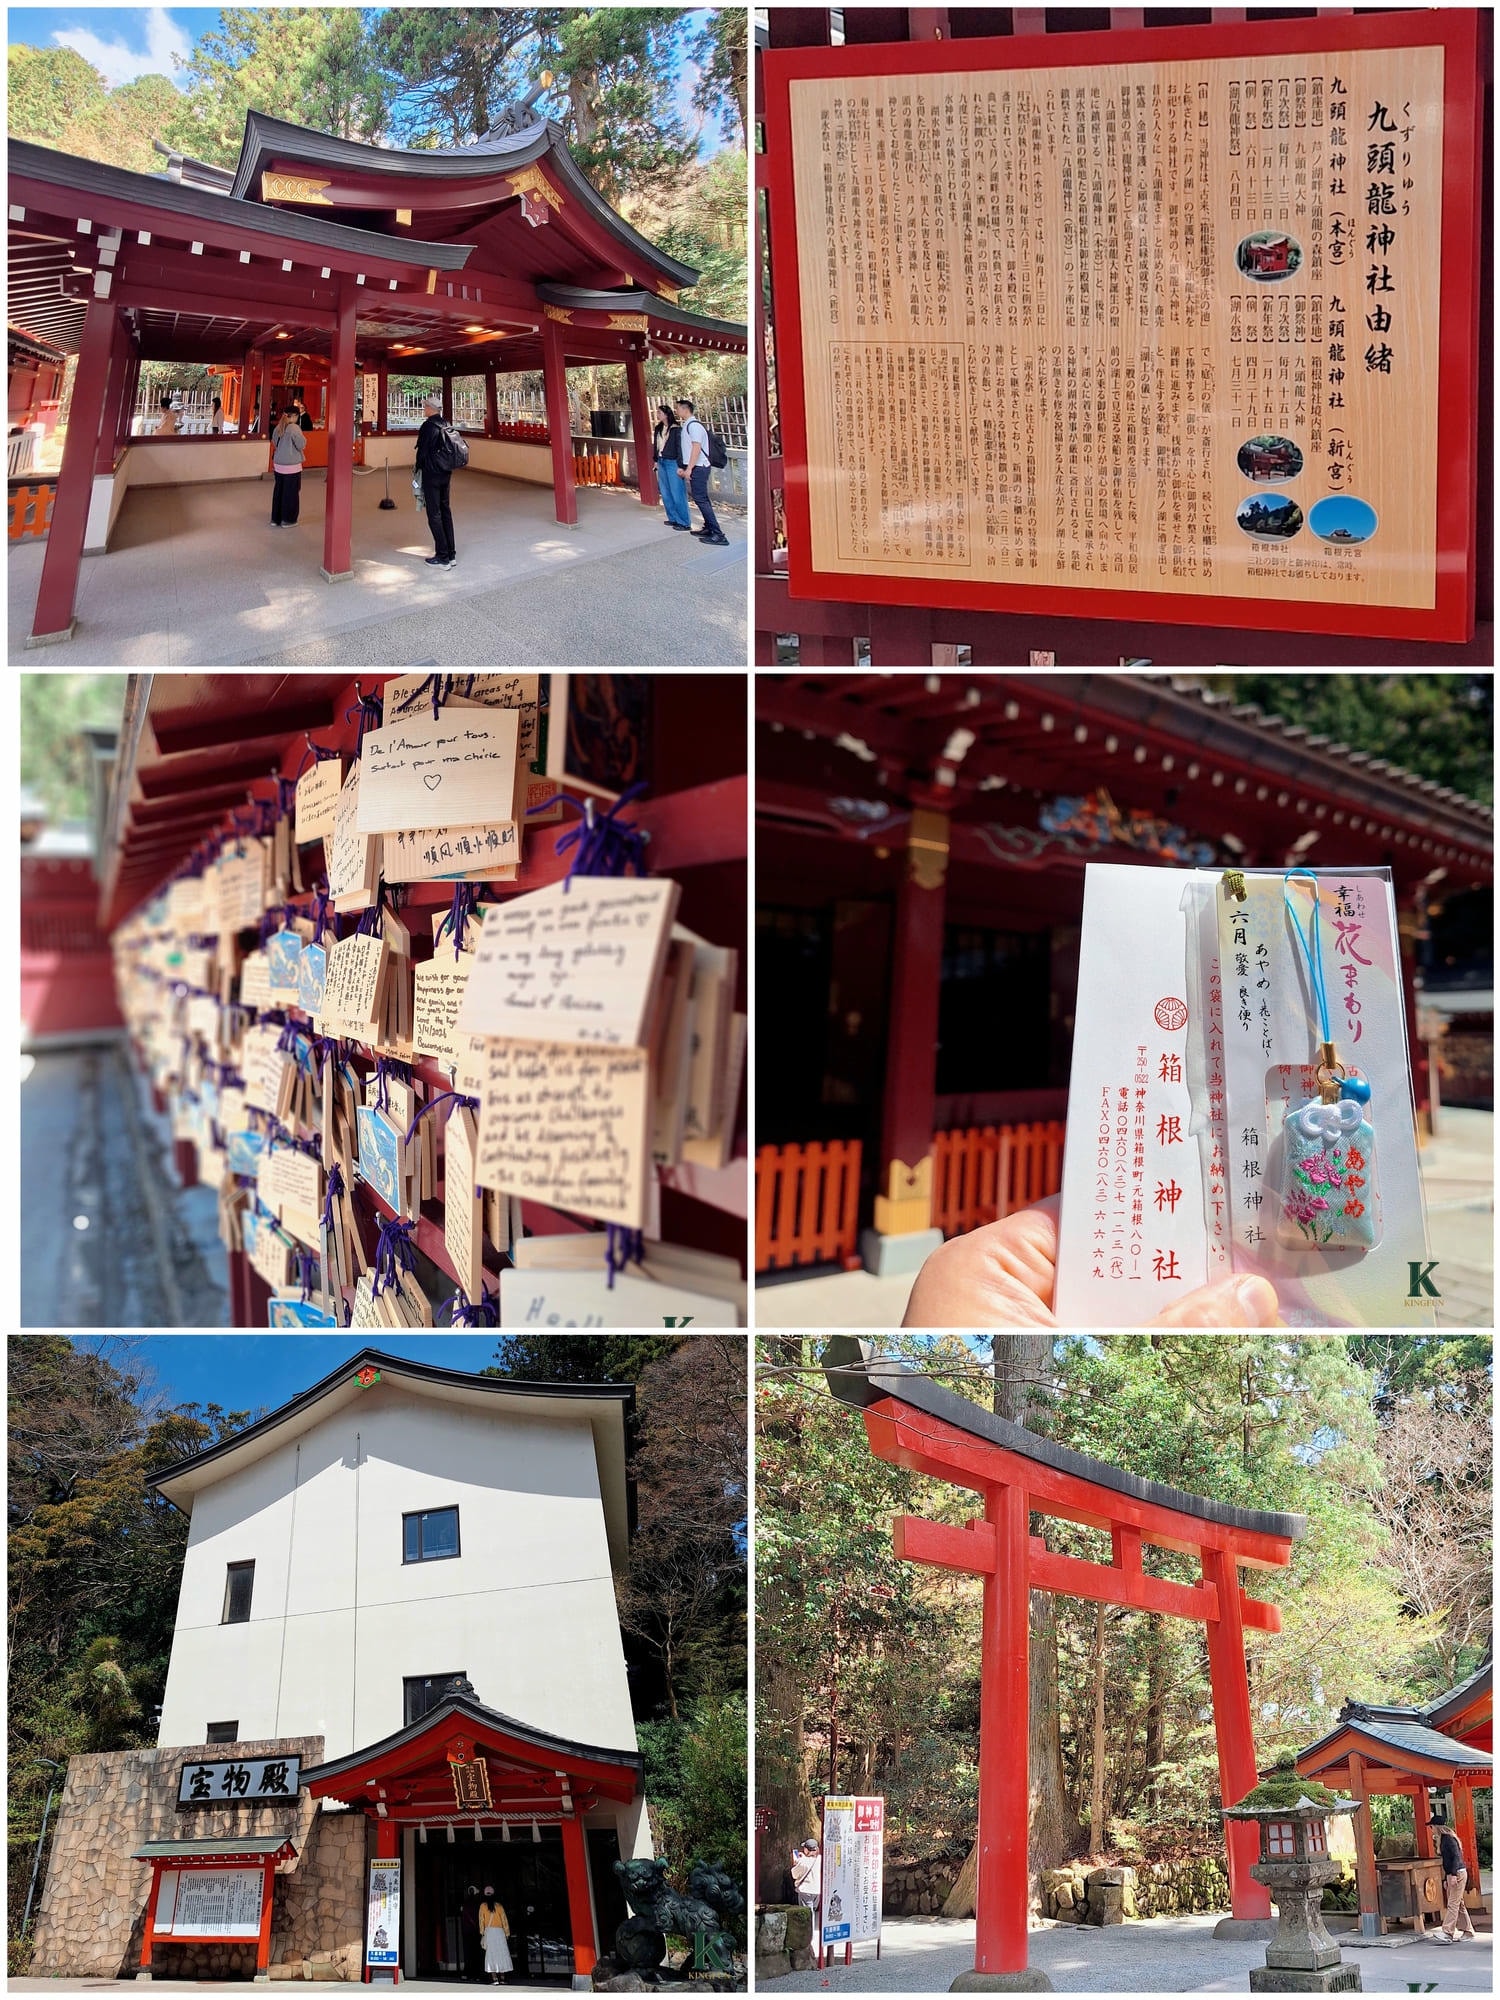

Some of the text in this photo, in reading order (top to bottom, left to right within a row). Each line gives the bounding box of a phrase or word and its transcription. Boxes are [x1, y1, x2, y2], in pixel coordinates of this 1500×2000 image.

[1230, 170, 1241, 220] 八月四日
[1295, 142, 1306, 217] 九頭龍大神
[1400, 101, 1416, 217] くずりゅう
[1347, 218, 1356, 259] ほんぐう
[1364, 100, 1398, 375] 九頭龍神社由緒
[1231, 356, 1242, 428] 七月三十一日
[1246, 356, 1258, 428] 四月二十九日
[1294, 356, 1306, 426] 九頭龍大神
[1310, 356, 1322, 453] 箱根神社境内鎮座
[1345, 439, 1354, 485] しんぐう
[1251, 543, 1289, 553] 箱根神社
[1324, 547, 1362, 558] 箱根元宮
[370, 744, 385, 756] De
[437, 736, 458, 748] pour
[413, 759, 435, 770] pour
[1356, 885, 1366, 919] しあわせ
[1229, 910, 1252, 1032] 六月 敬愛 良き便り
[1255, 943, 1271, 990] あやめ
[1332, 884, 1373, 1044] 幸福 花まもり
[1208, 958, 1226, 1262] この袋に入れて当神社にお納め下さい。
[1152, 1053, 1184, 1282] 箱根神社
[1241, 1127, 1266, 1244] 箱根神社
[1344, 1146, 1366, 1219] あやめ
[189, 1761, 291, 1800] 宝物殿
